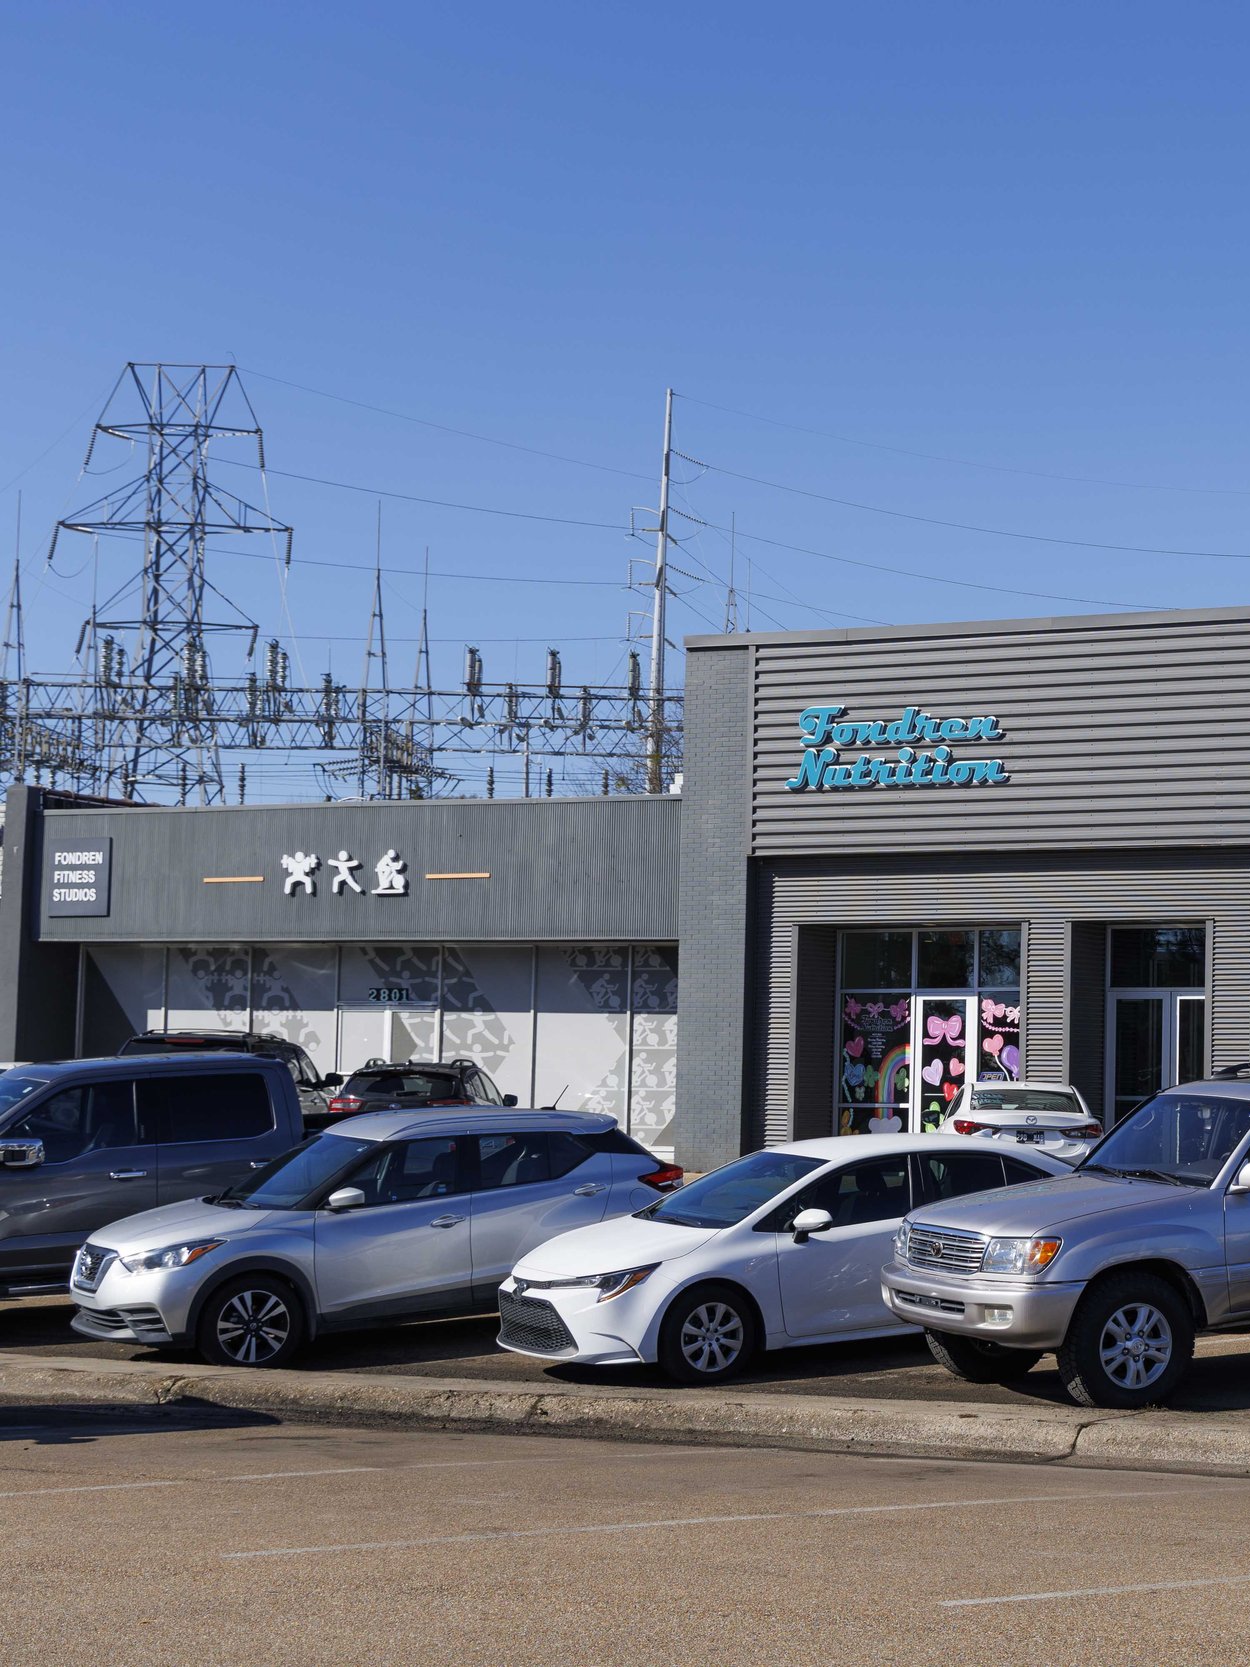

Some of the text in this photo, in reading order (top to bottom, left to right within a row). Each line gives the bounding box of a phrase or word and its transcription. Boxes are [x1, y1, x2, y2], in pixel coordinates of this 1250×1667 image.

[799, 705, 1003, 747] Fondren
[785, 746, 1009, 790] Nutrition
[54, 851, 104, 865] FONDREN
[53, 870, 96, 884] FITNESS
[52, 888, 97, 902] STUDIOS
[368, 989, 407, 1001] 2801
[982, 1073, 1004, 1081] OPEN
